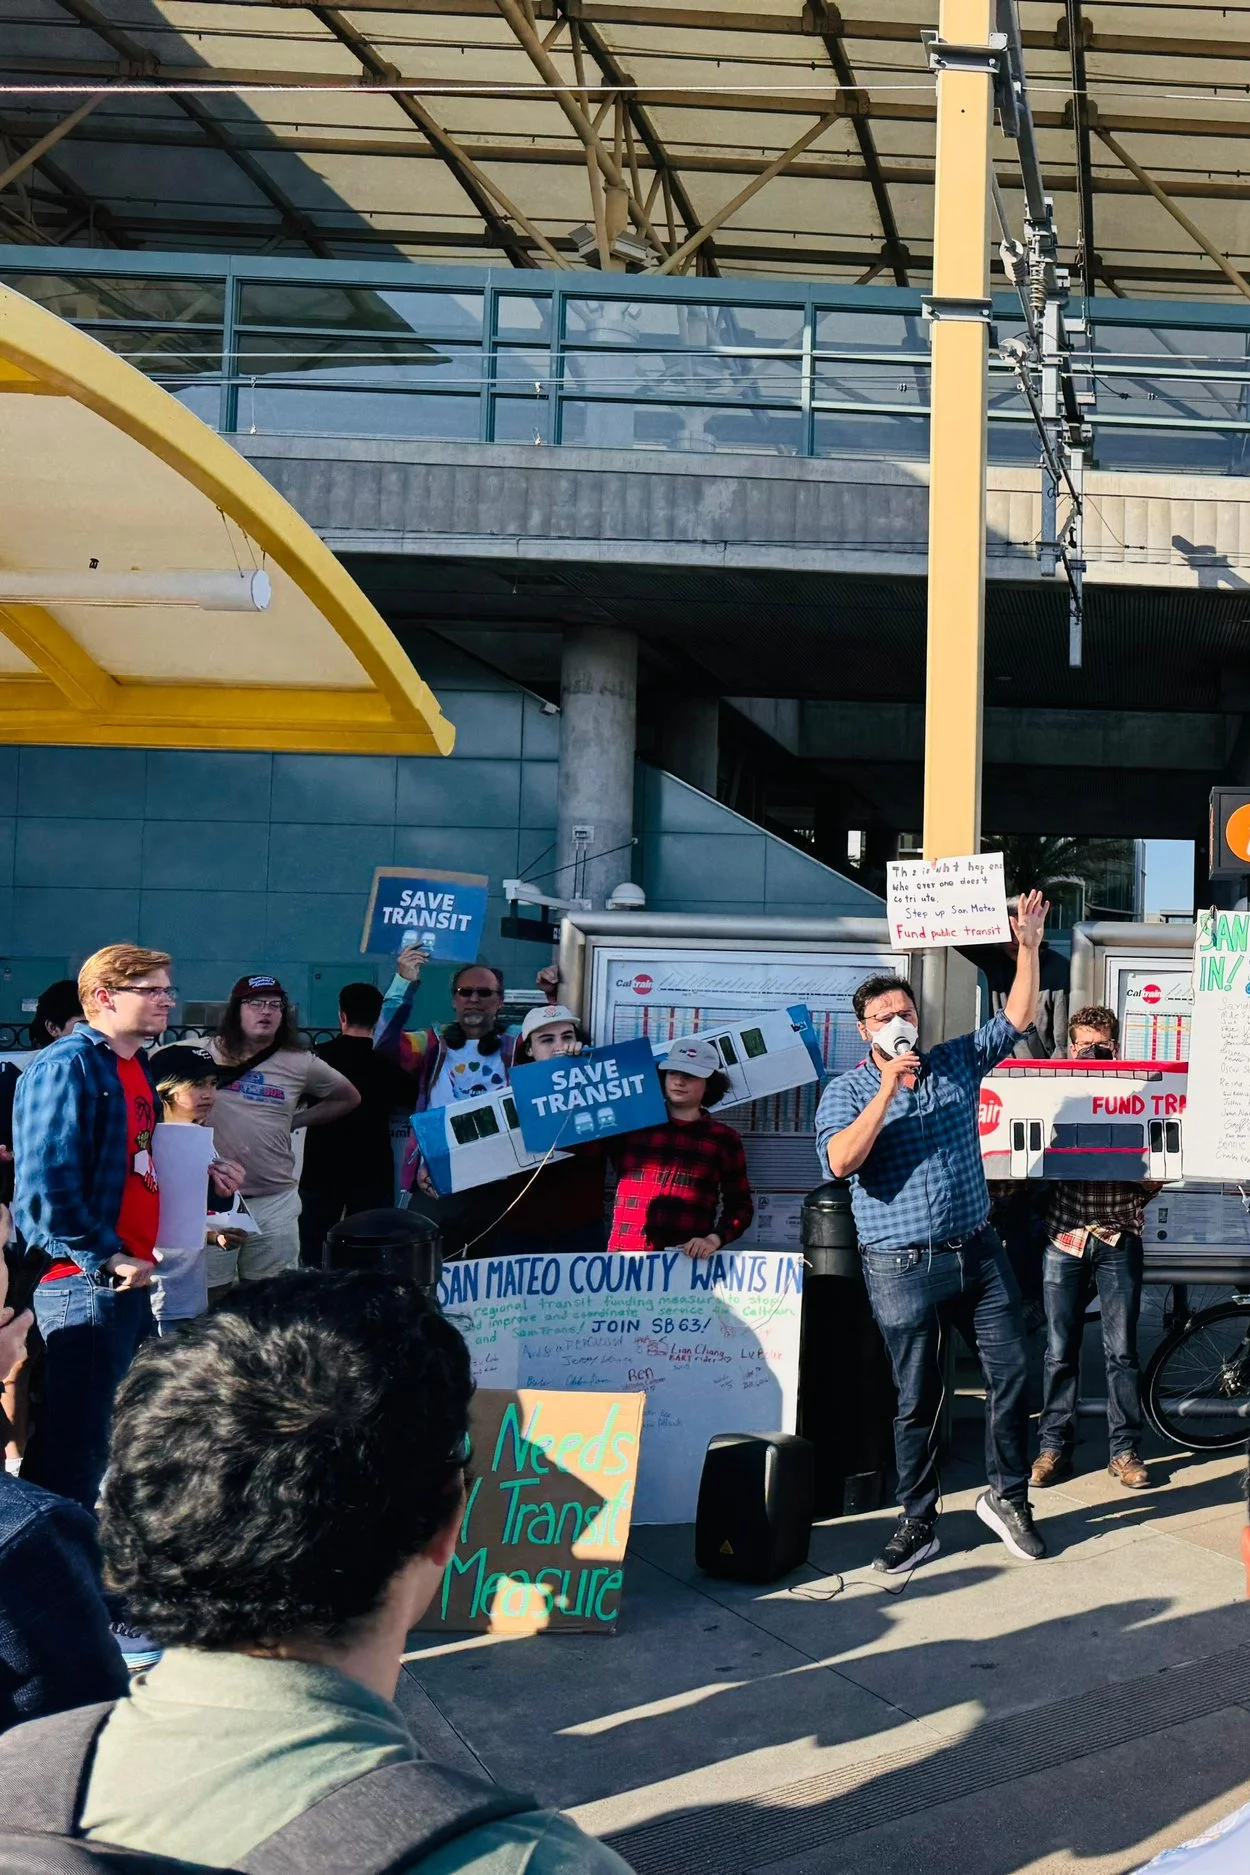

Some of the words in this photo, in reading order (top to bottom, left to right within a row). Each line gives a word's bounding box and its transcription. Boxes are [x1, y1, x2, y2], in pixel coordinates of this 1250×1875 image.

[399, 889, 455, 912] SAVE
[905, 907, 928, 919] Step
[935, 910, 946, 919] up
[951, 905, 968, 914] San
[971, 904, 996, 913] Mateo
[382, 906, 472, 942] TRANSIT
[896, 924, 927, 939] Fund
[931, 928, 958, 940] public
[963, 925, 1001, 937] transit
[1200, 913, 1250, 953] SAN
[1199, 955, 1245, 992] IN!
[551, 1059, 619, 1091] SAVE
[531, 1074, 645, 1117] TRANSIT
[1092, 1096, 1145, 1116] FUND
[437, 1262, 479, 1307] SAN
[486, 1257, 560, 1299] MATEO
[569, 1252, 680, 1294] COUNTY
[691, 1254, 767, 1293] WANTS
[775, 1256, 804, 1294] IN
[474, 1298, 528, 1318] regional
[538, 1295, 593, 1310] transit
[604, 1295, 654, 1312] funding
[729, 1294, 740, 1304] to
[750, 1294, 780, 1307] stop
[488, 1314, 537, 1329] improve
[545, 1310, 567, 1320] and
[573, 1307, 639, 1319] coordinate
[659, 1306, 704, 1317] service
[475, 1333, 497, 1345] and
[591, 1319, 640, 1333] JOIN
[492, 1401, 636, 1476] Needs
[500, 1478, 632, 1547] Transit
[441, 1548, 624, 1621] Measure
